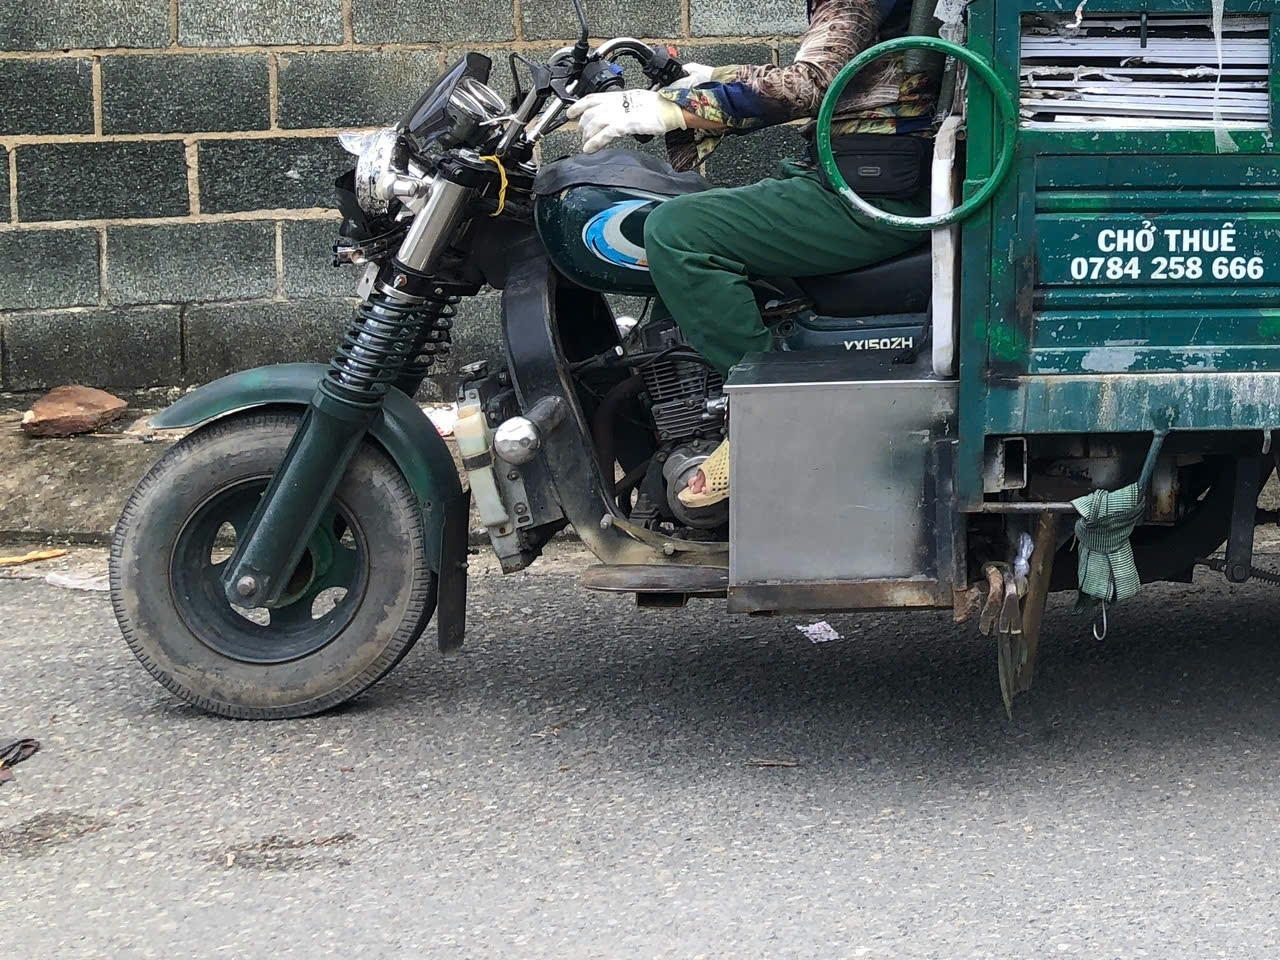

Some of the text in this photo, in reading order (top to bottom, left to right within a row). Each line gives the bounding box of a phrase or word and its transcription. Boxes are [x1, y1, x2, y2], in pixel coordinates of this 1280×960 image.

[1097, 220, 1236, 252] CHỞ THUÊ
[1070, 256, 1264, 280] 0784 258 666
